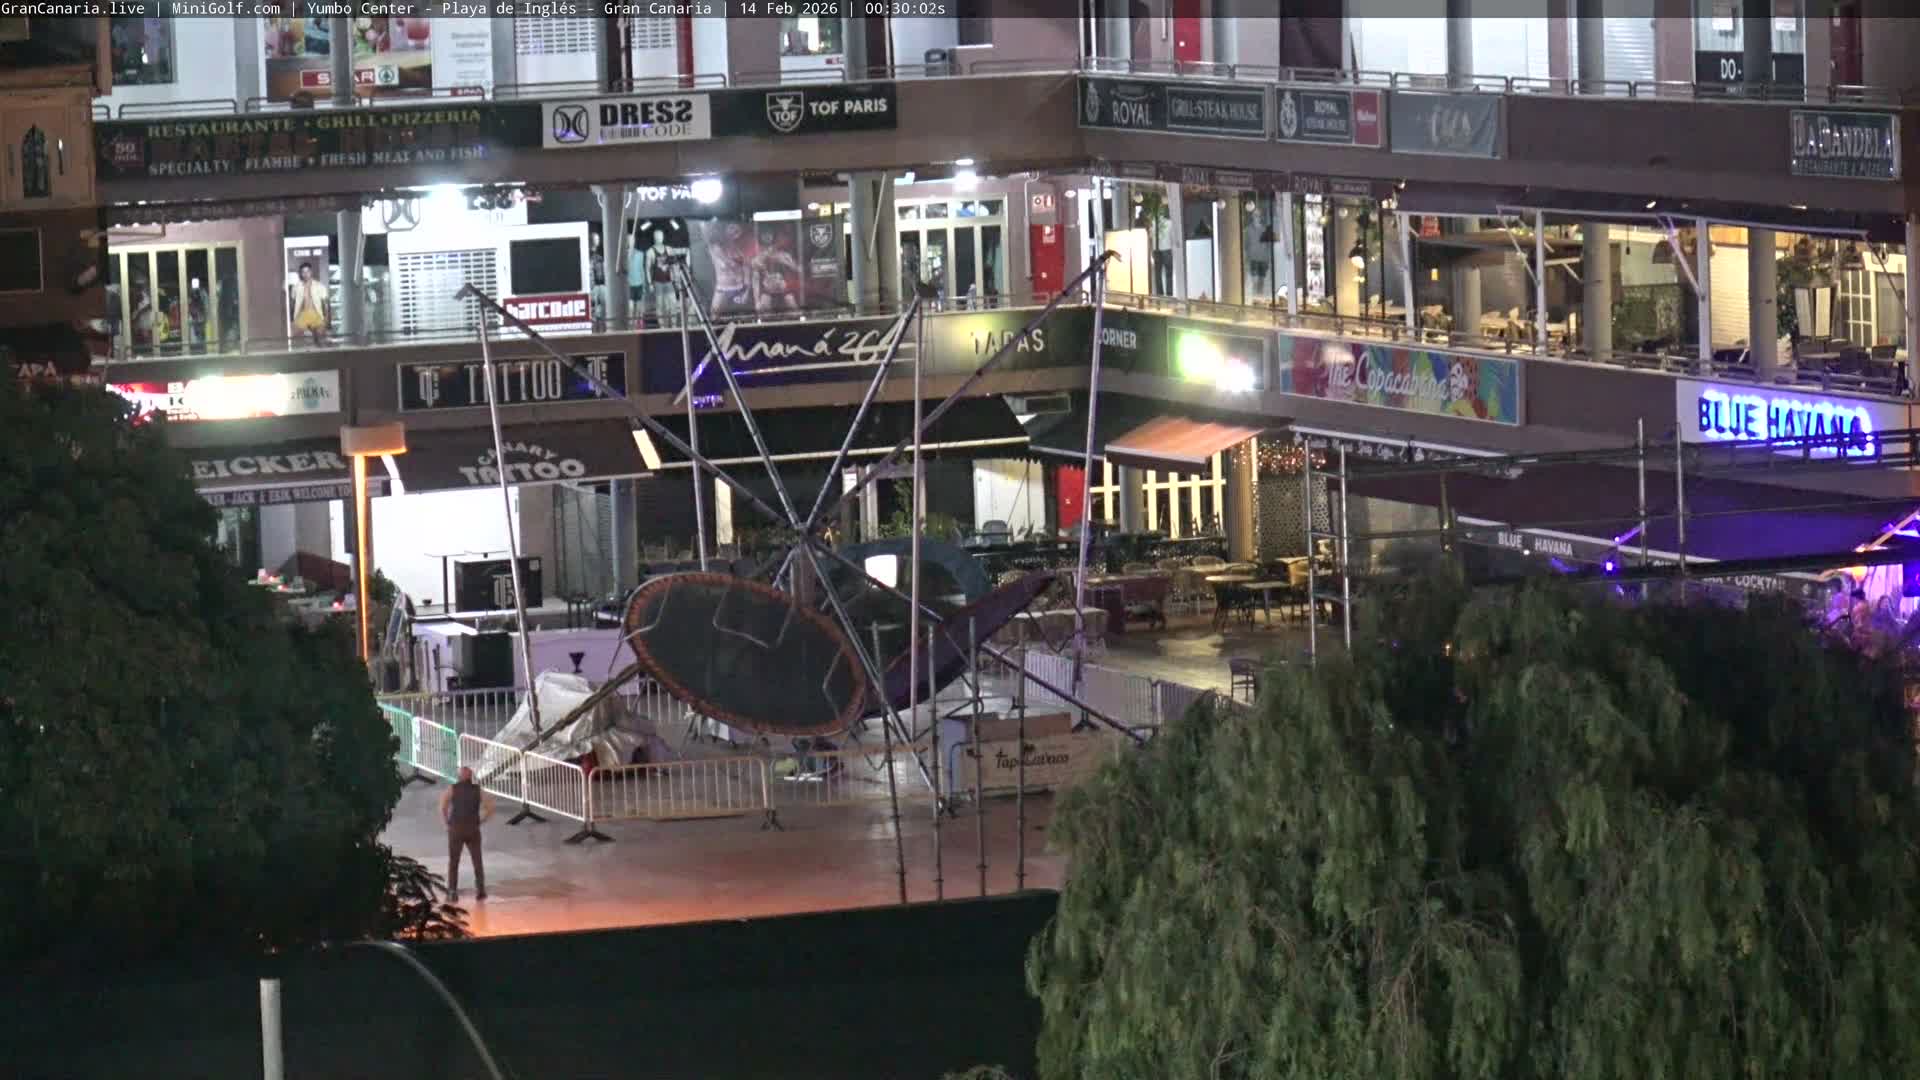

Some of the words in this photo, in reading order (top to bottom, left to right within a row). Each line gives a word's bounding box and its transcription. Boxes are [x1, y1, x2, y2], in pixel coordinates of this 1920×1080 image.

[774, 110, 798, 123] TOF
[808, 101, 840, 115] TOF
[844, 97, 888, 114] PARIS
[1112, 101, 1153, 126] ROYAL
[148, 117, 295, 138] RESTAURANTE
[317, 113, 378, 130] GRILL
[391, 109, 481, 126] PIZZERIA
[642, 123, 692, 138] CODE
[149, 160, 231, 176] SPECIALTY
[320, 151, 367, 166] FRESH
[416, 149, 446, 161] AND
[451, 145, 484, 160] FISH
[1099, 328, 1137, 349] ORNER
[464, 361, 562, 402] TATTOO
[1699, 392, 1766, 440] BLUE
[189, 452, 345, 478] EICKER
[460, 459, 584, 484] TATTOO
[1498, 532, 1522, 550] BLUE
[1534, 537, 1573, 557] HAVANA
